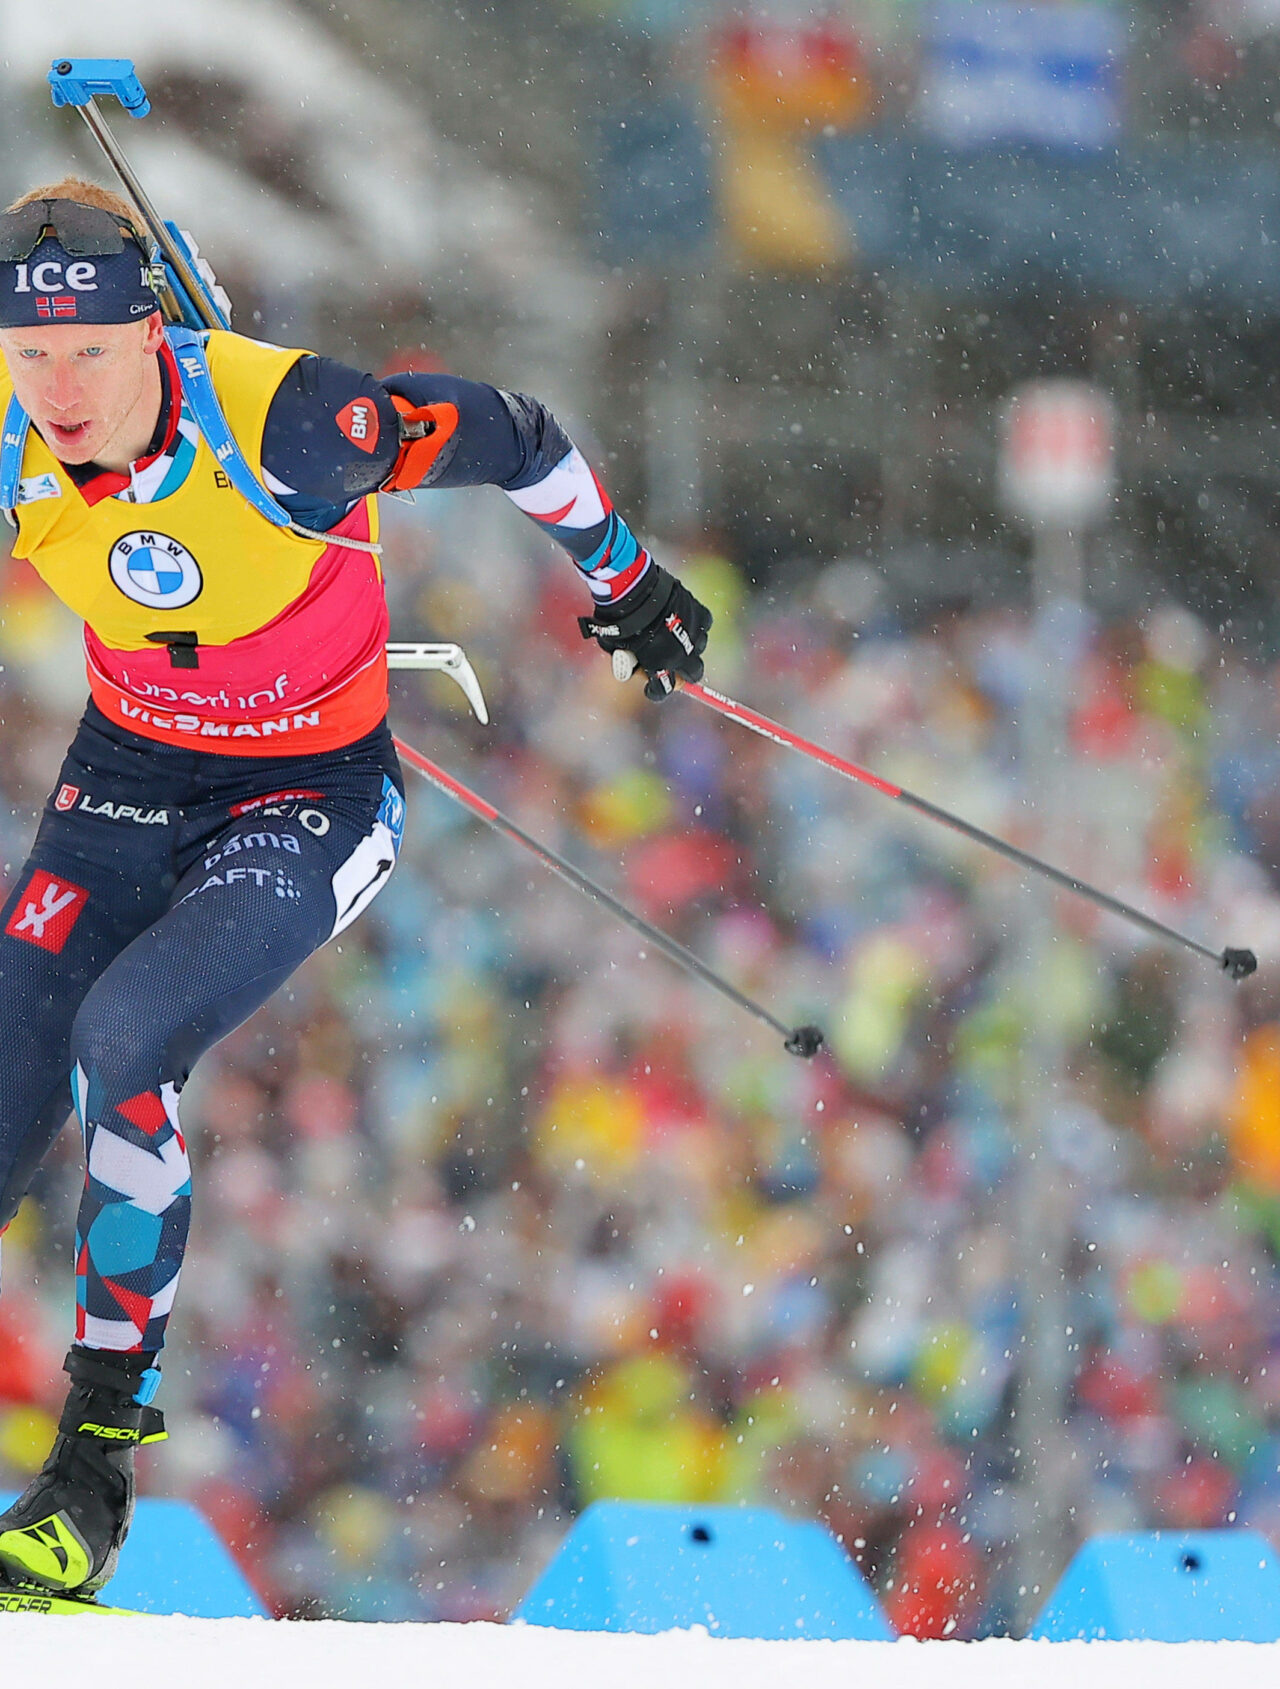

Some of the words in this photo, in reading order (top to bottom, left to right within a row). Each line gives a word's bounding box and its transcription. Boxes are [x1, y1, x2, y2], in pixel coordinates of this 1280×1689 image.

[350, 405, 368, 440] BM
[117, 534, 184, 558] BMW
[78, 794, 170, 826] LAPUA
[78, 1422, 140, 1441] FISCH
